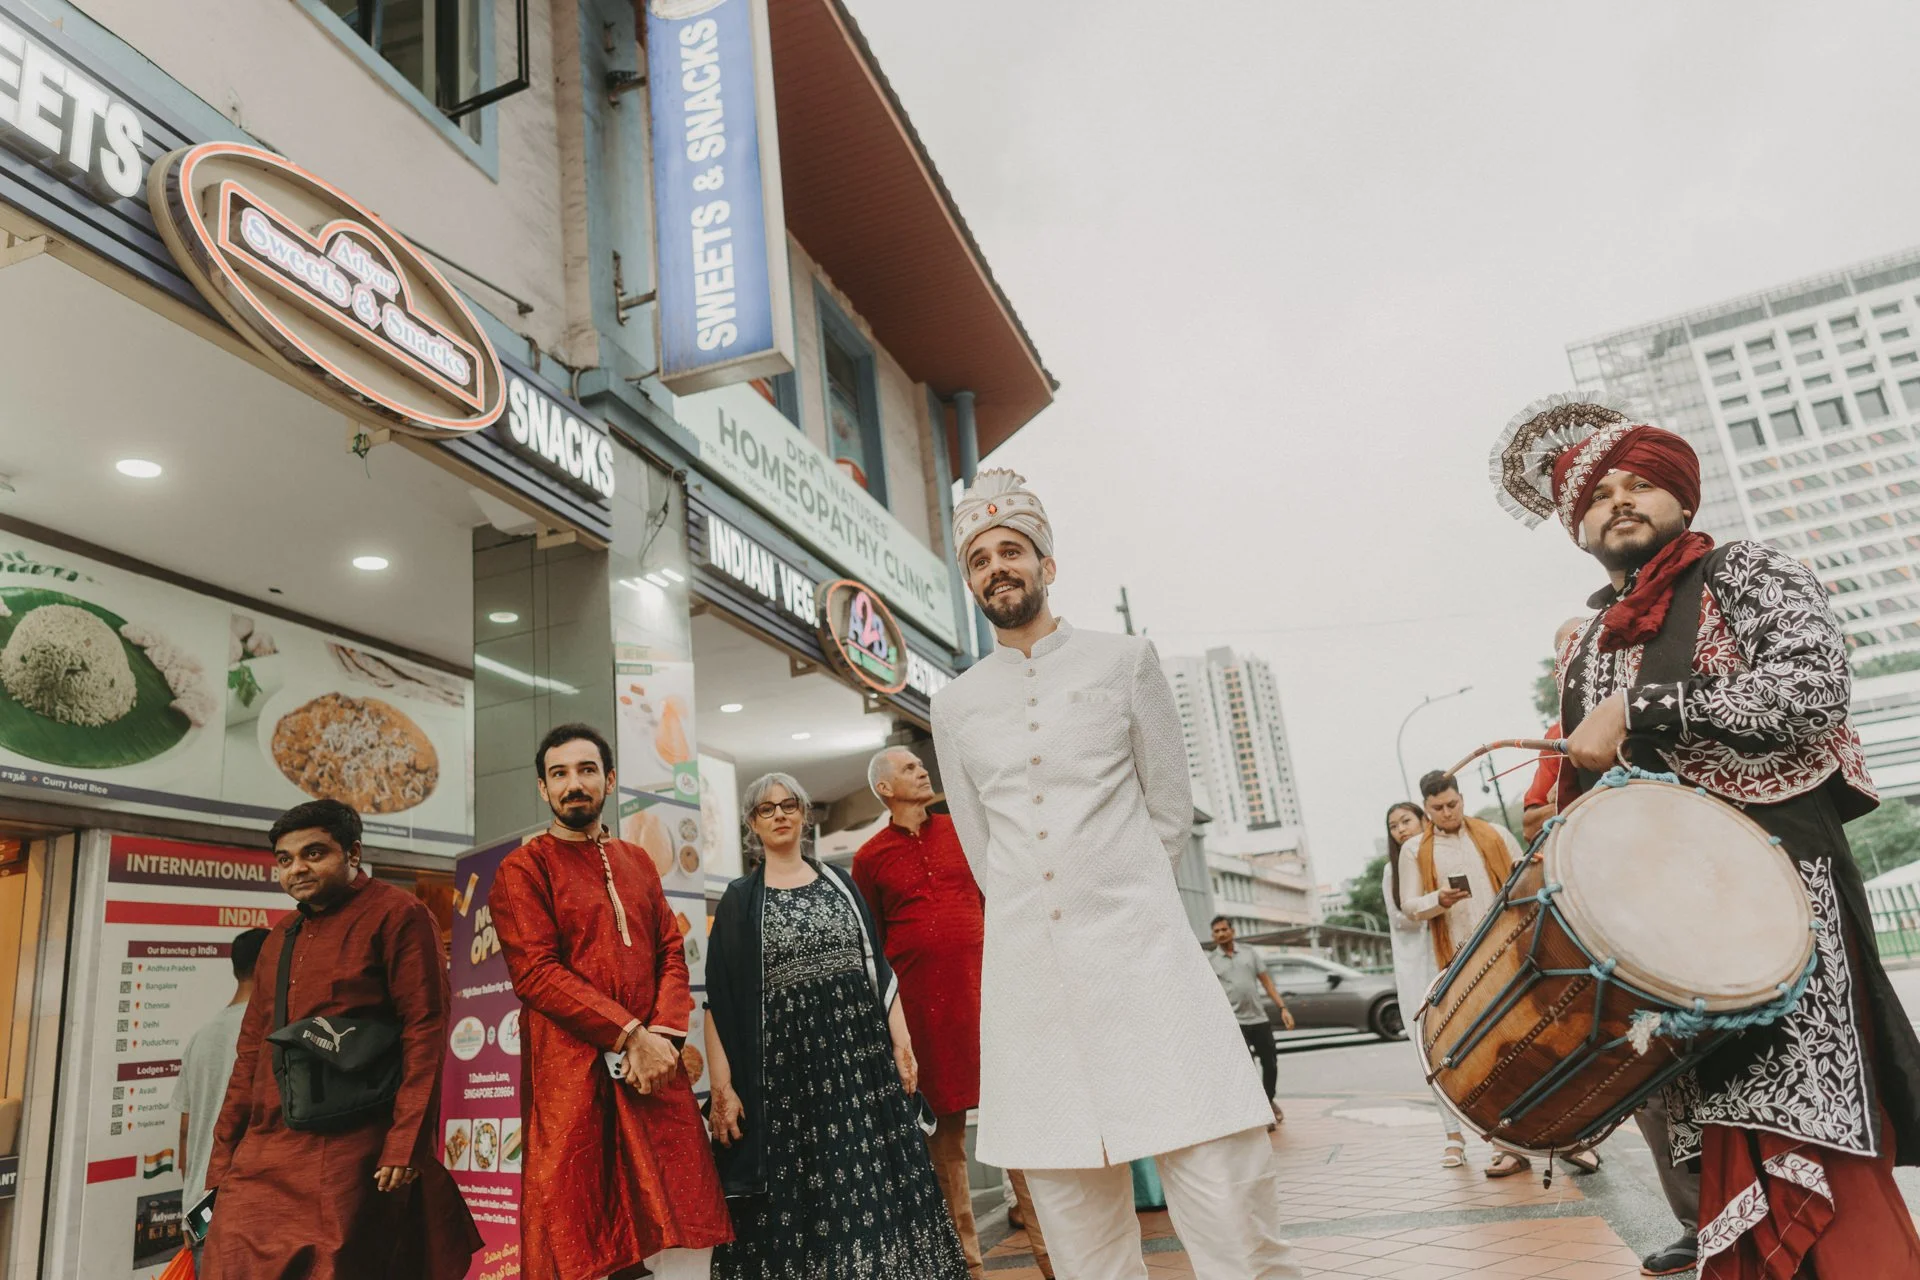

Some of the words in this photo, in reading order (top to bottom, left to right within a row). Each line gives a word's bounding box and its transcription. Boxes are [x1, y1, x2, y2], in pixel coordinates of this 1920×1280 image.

[678, 18, 726, 162] SNACKS
[692, 163, 725, 191] &
[330, 235, 398, 299] Adyar
[693, 196, 738, 352] SWEETS
[243, 209, 349, 306] Sweets
[354, 285, 380, 328] &
[384, 304, 468, 384] Snacks
[508, 377, 615, 499] SNACKS
[717, 407, 880, 568] HOMEOPATHY
[884, 549, 936, 612] CLINIC
[707, 514, 777, 601] INDIAN
[779, 560, 821, 629] VEG.
[42, 776, 67, 789] Curry
[69, 780, 88, 792] Leaf
[89, 784, 108, 795] Rice
[126, 853, 266, 882] INTERNATIONAL
[218, 907, 269, 927] INDIA
[147, 947, 160, 955] Our
[160, 947, 189, 955] Branches
[190, 947, 197, 956] @
[198, 945, 218, 955] India
[171, 964, 196, 972] Pradesh
[145, 983, 178, 991] Bangalore
[143, 1020, 159, 1029] Delhi
[142, 1039, 179, 1047] Puducherry
[303, 1030, 334, 1051] PUMA
[137, 1065, 164, 1075] Lodges
[138, 1103, 169, 1112] Perambur
[151, 1212, 176, 1223] Adyar
